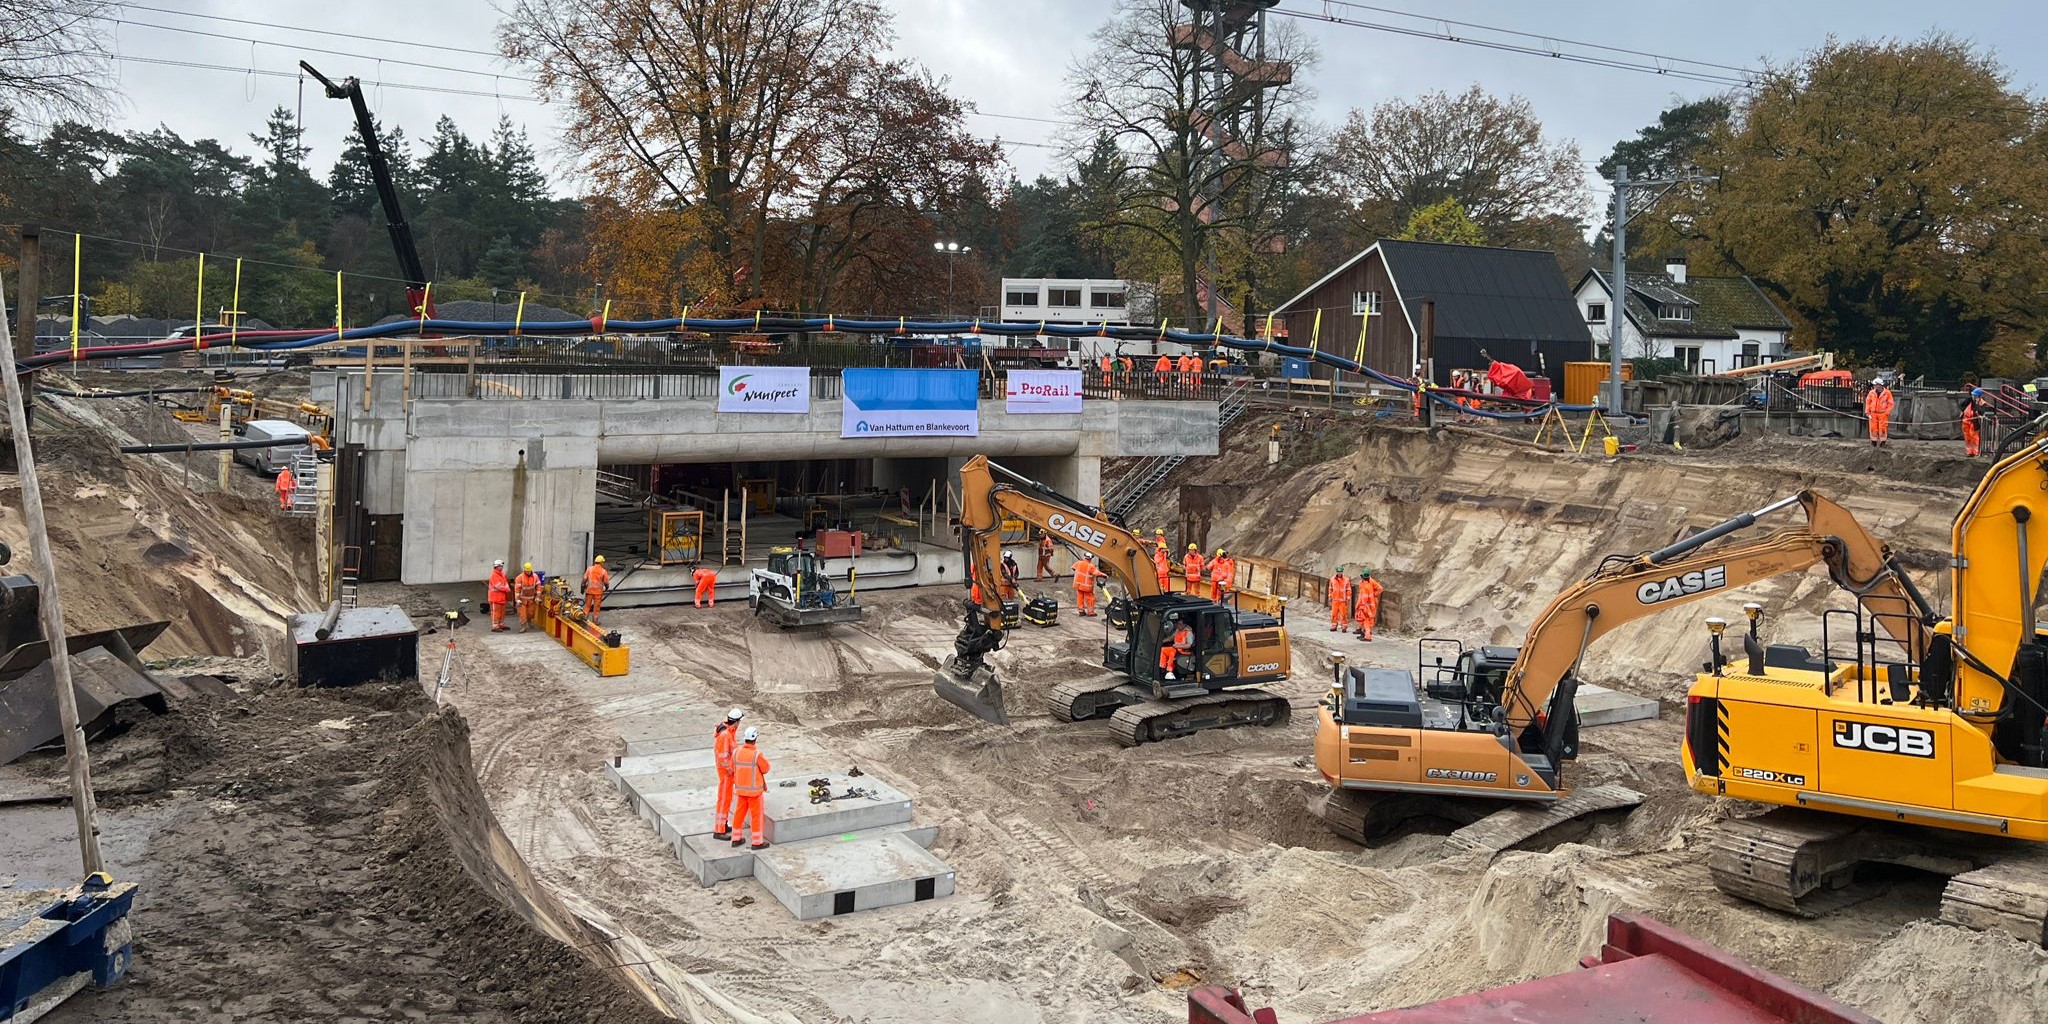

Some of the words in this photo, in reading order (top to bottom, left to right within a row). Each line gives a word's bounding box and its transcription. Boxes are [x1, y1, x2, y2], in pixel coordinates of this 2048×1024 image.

[744, 388, 798, 402] Nunspeet
[1021, 383, 1069, 396] ProRail
[870, 424, 884, 432] Van
[885, 423, 914, 431] Hattum
[926, 423, 970, 431] Blankevoort
[1048, 513, 1107, 548] CASE
[1638, 565, 1725, 605] CASE
[1247, 662, 1279, 672] CX210D
[1835, 723, 1933, 756] JCB
[1427, 768, 1497, 782] CX300C
[1787, 776, 1804, 785] LC
